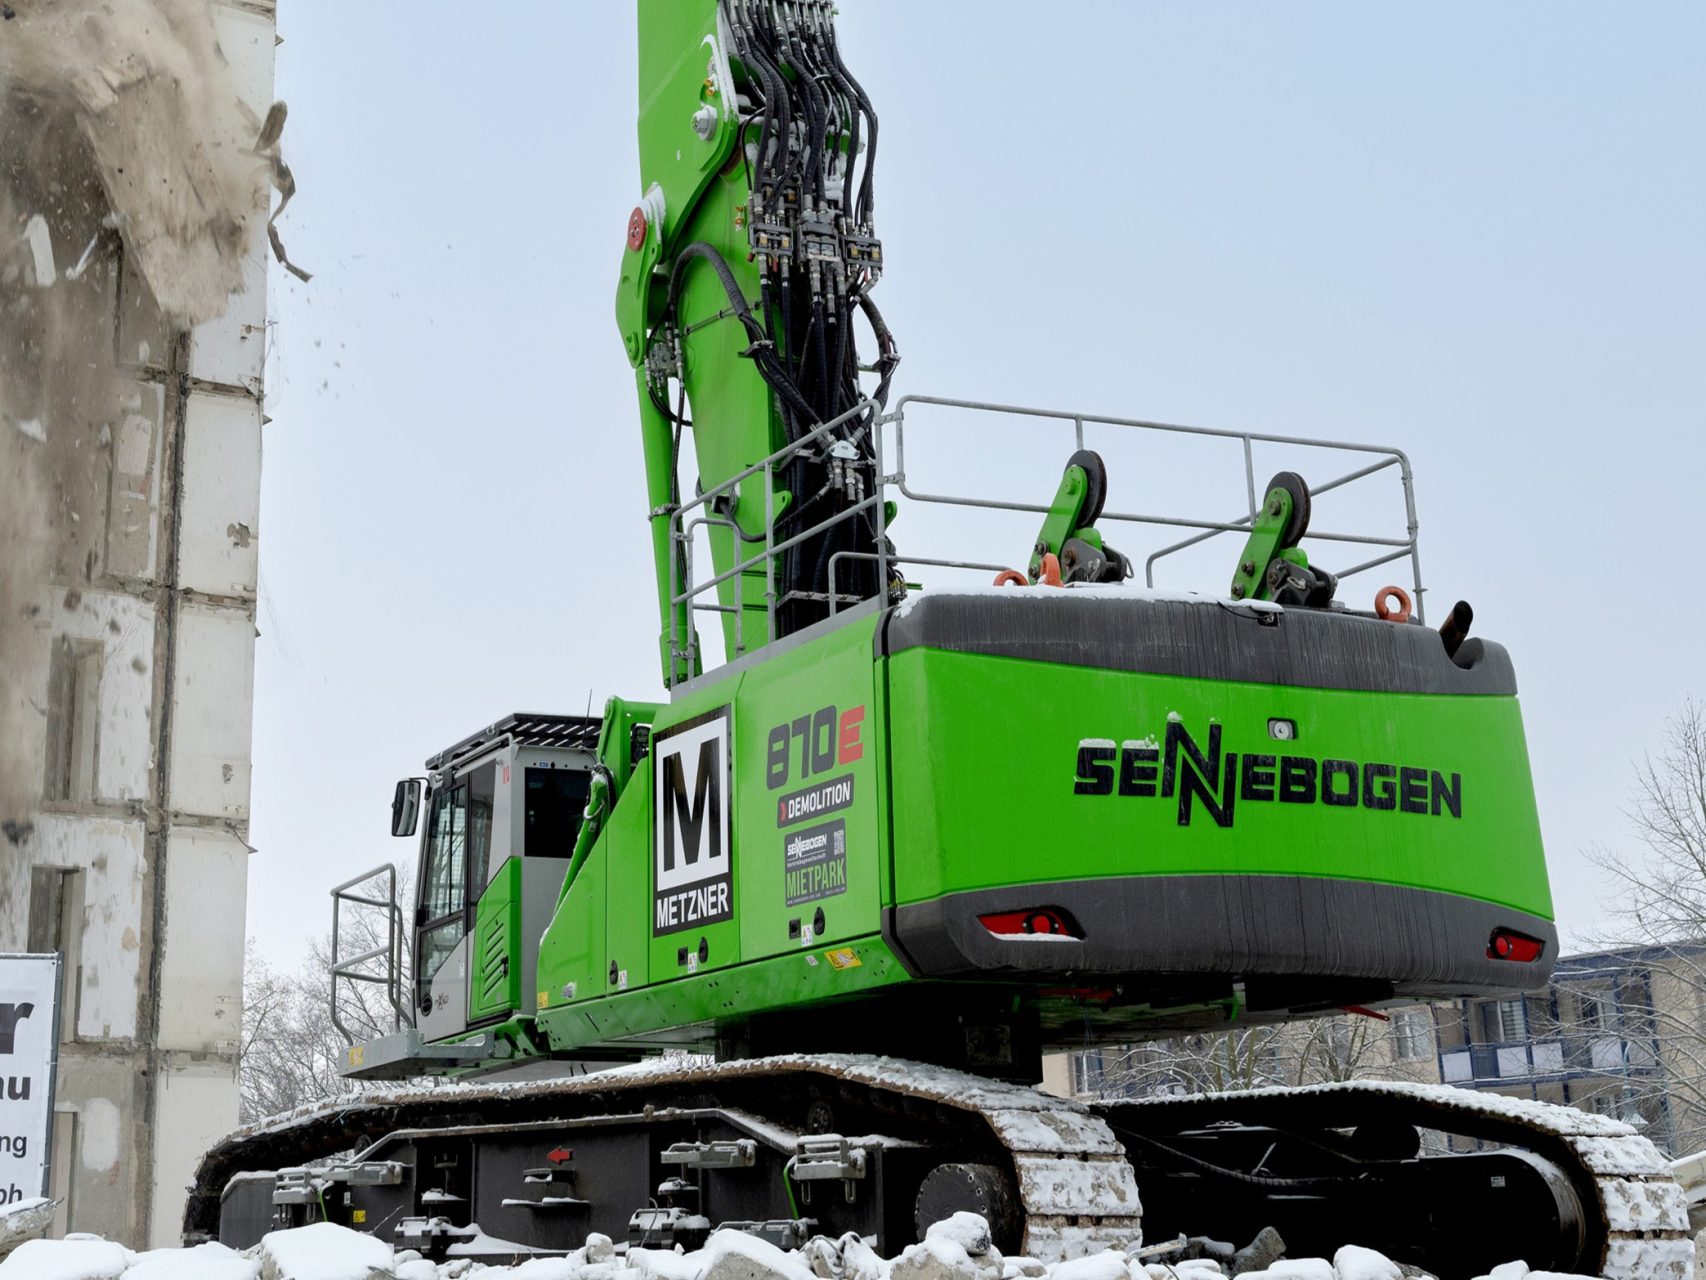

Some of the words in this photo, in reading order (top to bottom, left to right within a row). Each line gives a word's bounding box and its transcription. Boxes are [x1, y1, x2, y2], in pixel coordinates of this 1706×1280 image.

[767, 705, 865, 790] 870E
[1073, 720, 1462, 828] SENNEBOGEN
[662, 736, 722, 873] M
[788, 781, 851, 819] DEMOLITION
[787, 833, 828, 858] SENNEBOGEN
[786, 858, 846, 899] MIETPARK
[656, 882, 730, 929] METZNER
